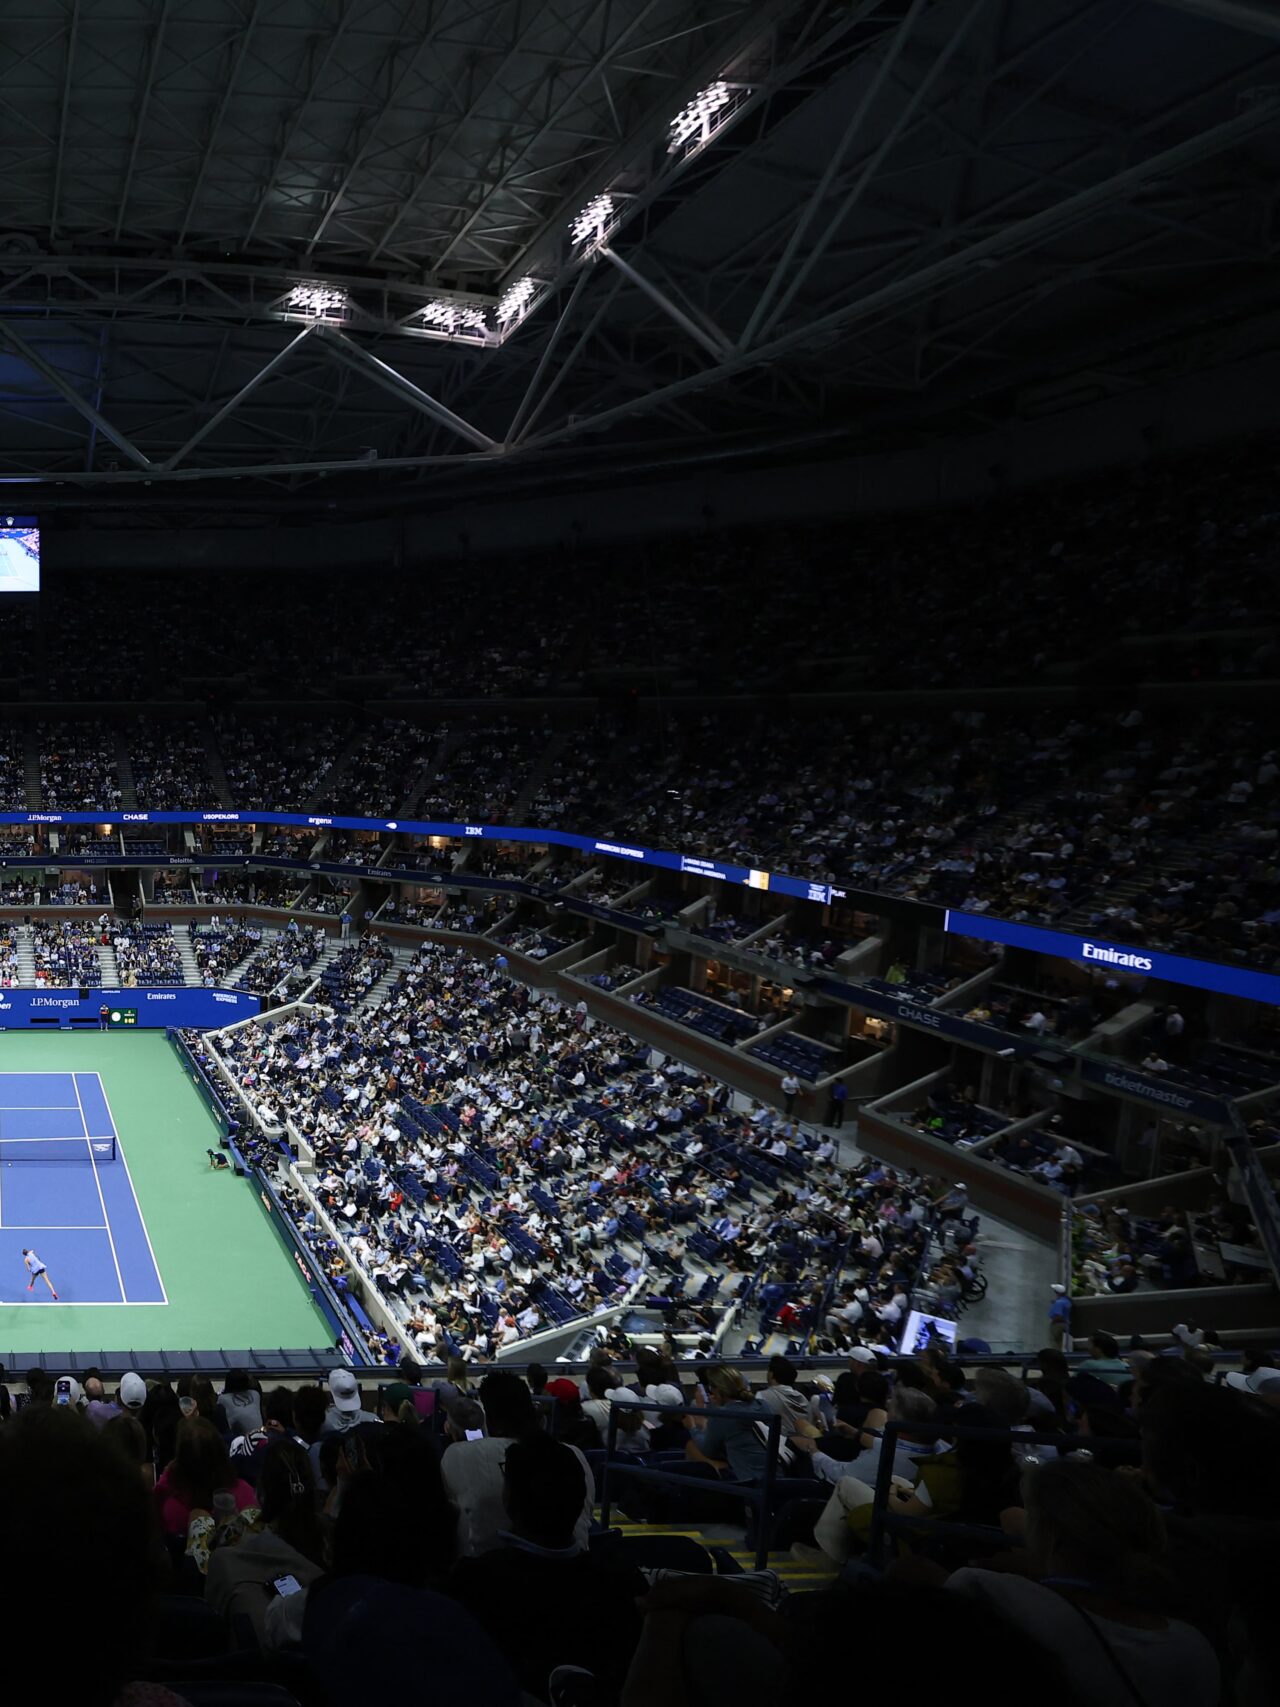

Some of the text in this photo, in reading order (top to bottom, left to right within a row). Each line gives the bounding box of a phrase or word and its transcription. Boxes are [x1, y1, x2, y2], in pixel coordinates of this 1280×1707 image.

[27, 814, 62, 823] J.P.Morgan
[308, 817, 333, 826] argenx
[465, 826, 483, 836] IBM
[1082, 942, 1153, 971] Emirates
[147, 992, 177, 1000] Emirates
[30, 997, 80, 1008] J.P.Morgan
[897, 1005, 941, 1028] CHASE
[1104, 1072, 1195, 1108] ticketmaster
